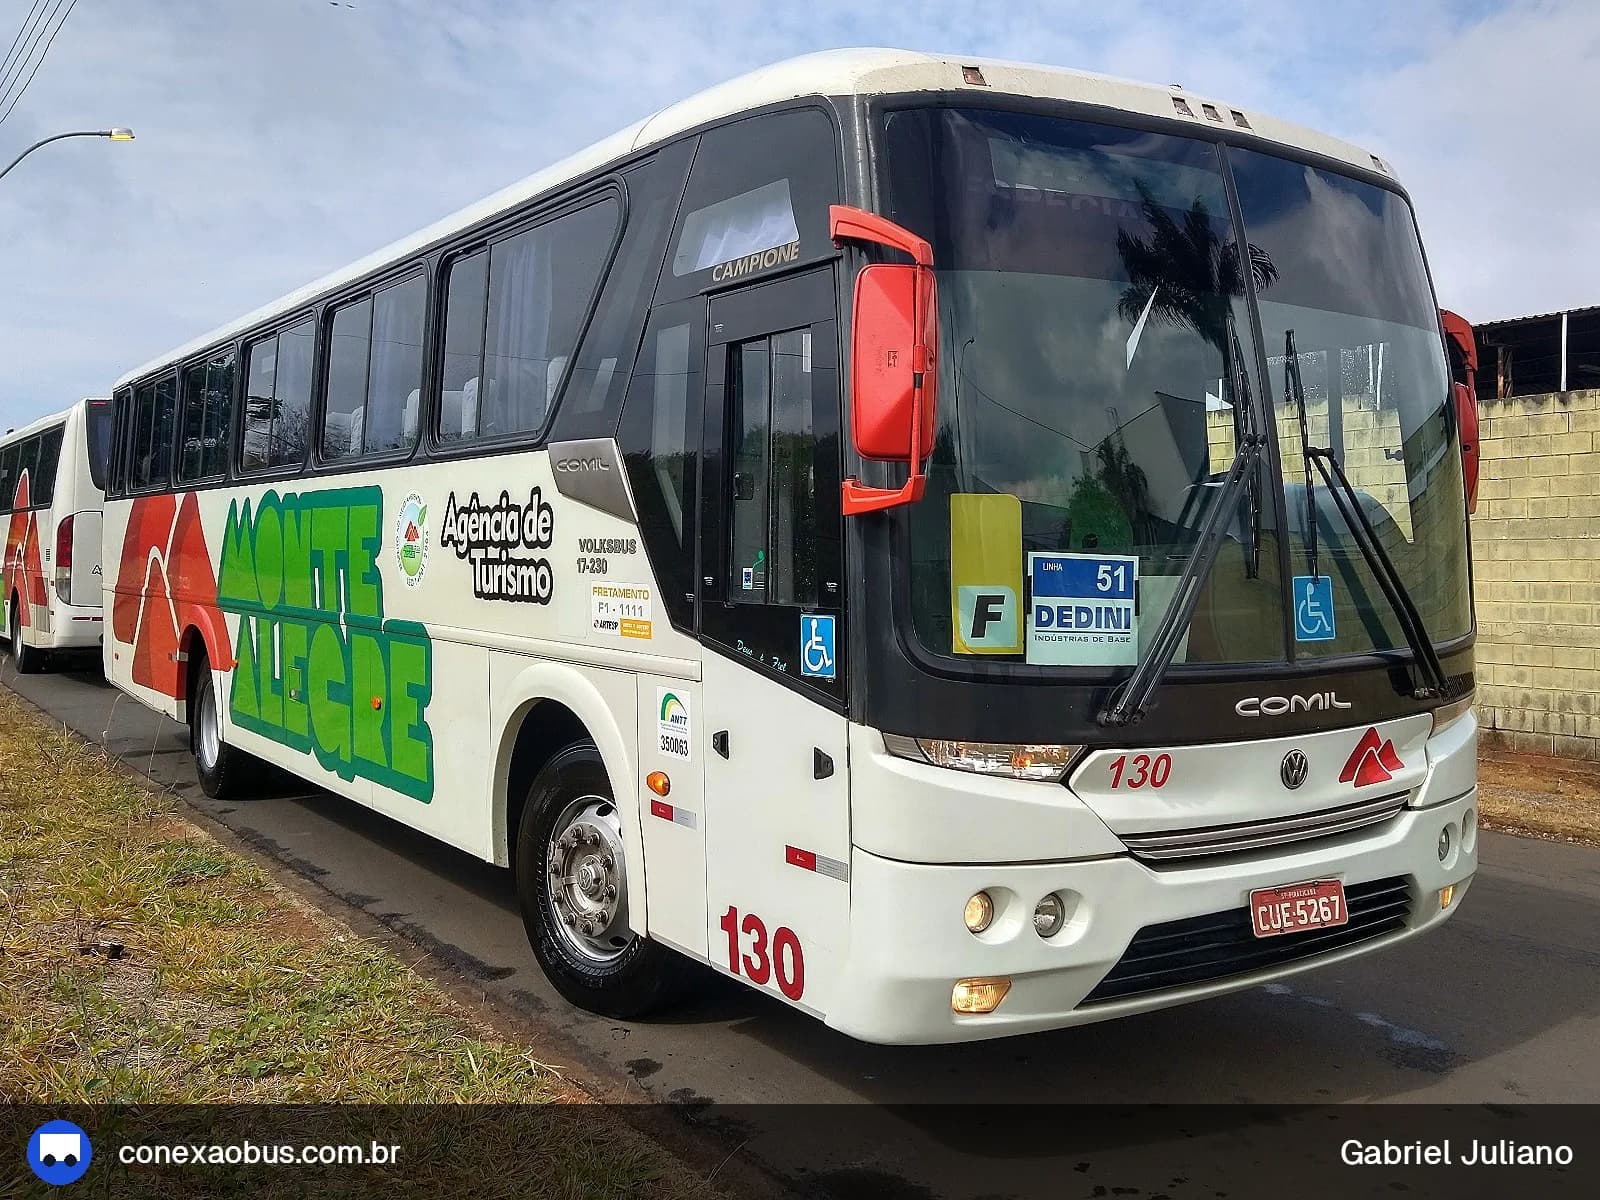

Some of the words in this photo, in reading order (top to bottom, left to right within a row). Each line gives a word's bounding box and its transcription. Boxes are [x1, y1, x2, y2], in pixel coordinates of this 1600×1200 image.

[712, 242, 800, 282] CAMPIONE
[556, 457, 610, 472] COMIL
[441, 490, 521, 558] Agência
[521, 487, 553, 548] de
[219, 499, 380, 618] MONTE
[578, 538, 637, 555] VOLKSBUS
[470, 548, 553, 605] Turismo
[577, 557, 608, 574] 17-230
[1042, 562, 1063, 572] LINHA
[1096, 565, 1127, 593] 51
[592, 586, 650, 600] FRETAMENTO
[598, 602, 609, 613] F1
[620, 603, 643, 617] 1111
[970, 595, 1006, 638] F
[1035, 604, 1131, 630] DEDINI
[599, 619, 619, 631] ARTESP
[232, 614, 429, 785] ALEGRE
[1235, 691, 1352, 717] COMIL
[670, 714, 688, 726] ANTT
[660, 734, 689, 757] 350063
[1108, 753, 1172, 789] 130
[720, 905, 805, 1001] 130
